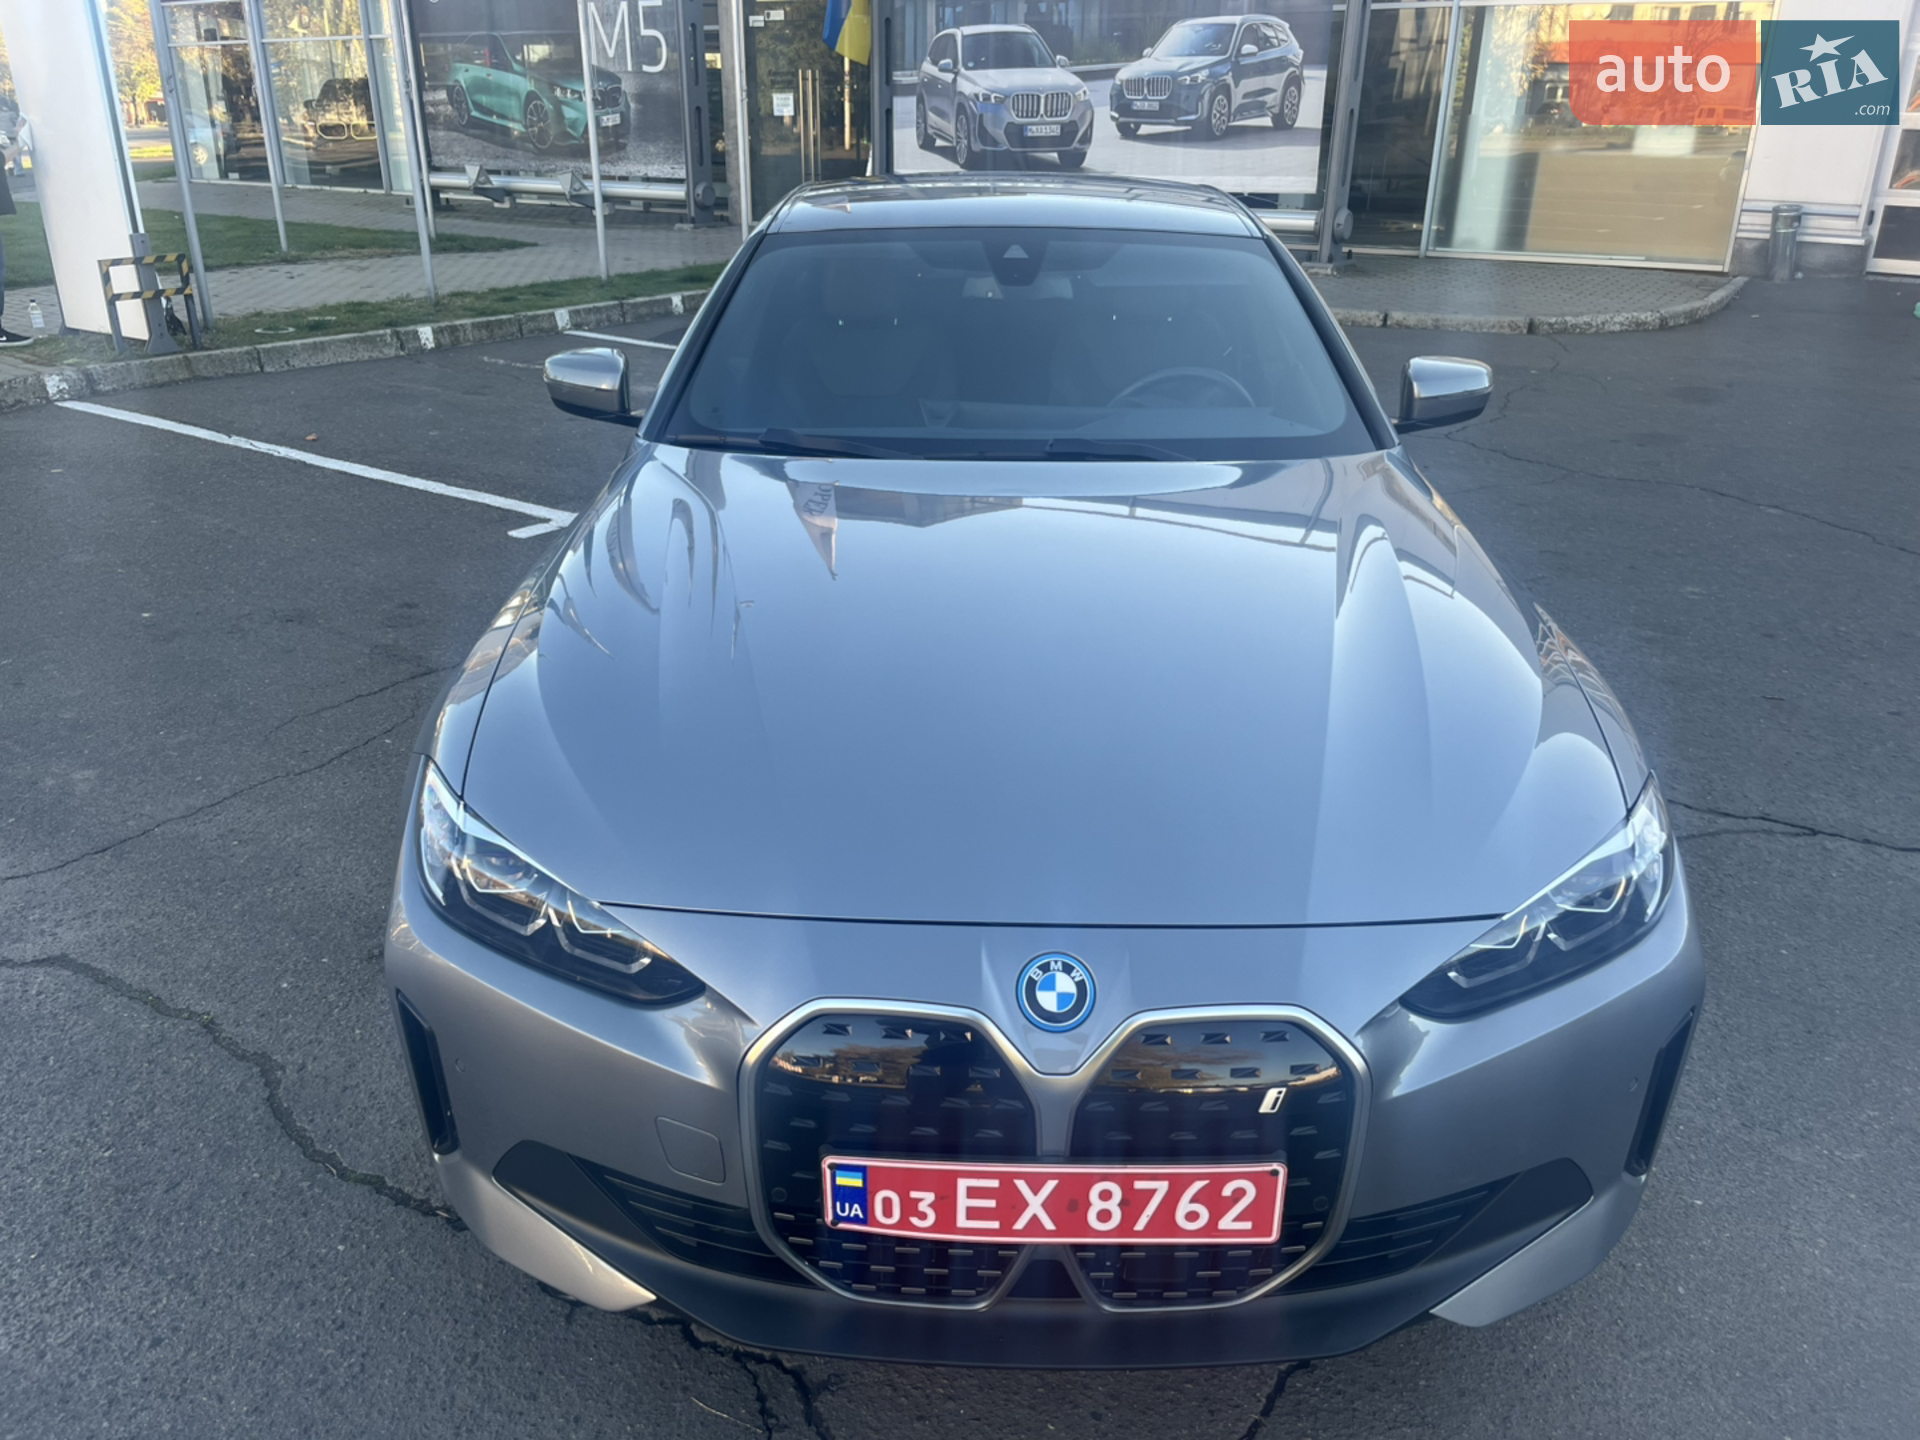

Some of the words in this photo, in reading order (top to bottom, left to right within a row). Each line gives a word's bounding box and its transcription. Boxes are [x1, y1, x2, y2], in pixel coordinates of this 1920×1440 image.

[586, 0, 668, 73] M5
[1030, 960, 1084, 982] BMW
[836, 1201, 864, 1219] UA
[873, 1188, 937, 1229] 03
[956, 1177, 1060, 1231] EX
[1086, 1178, 1258, 1232] 8762
